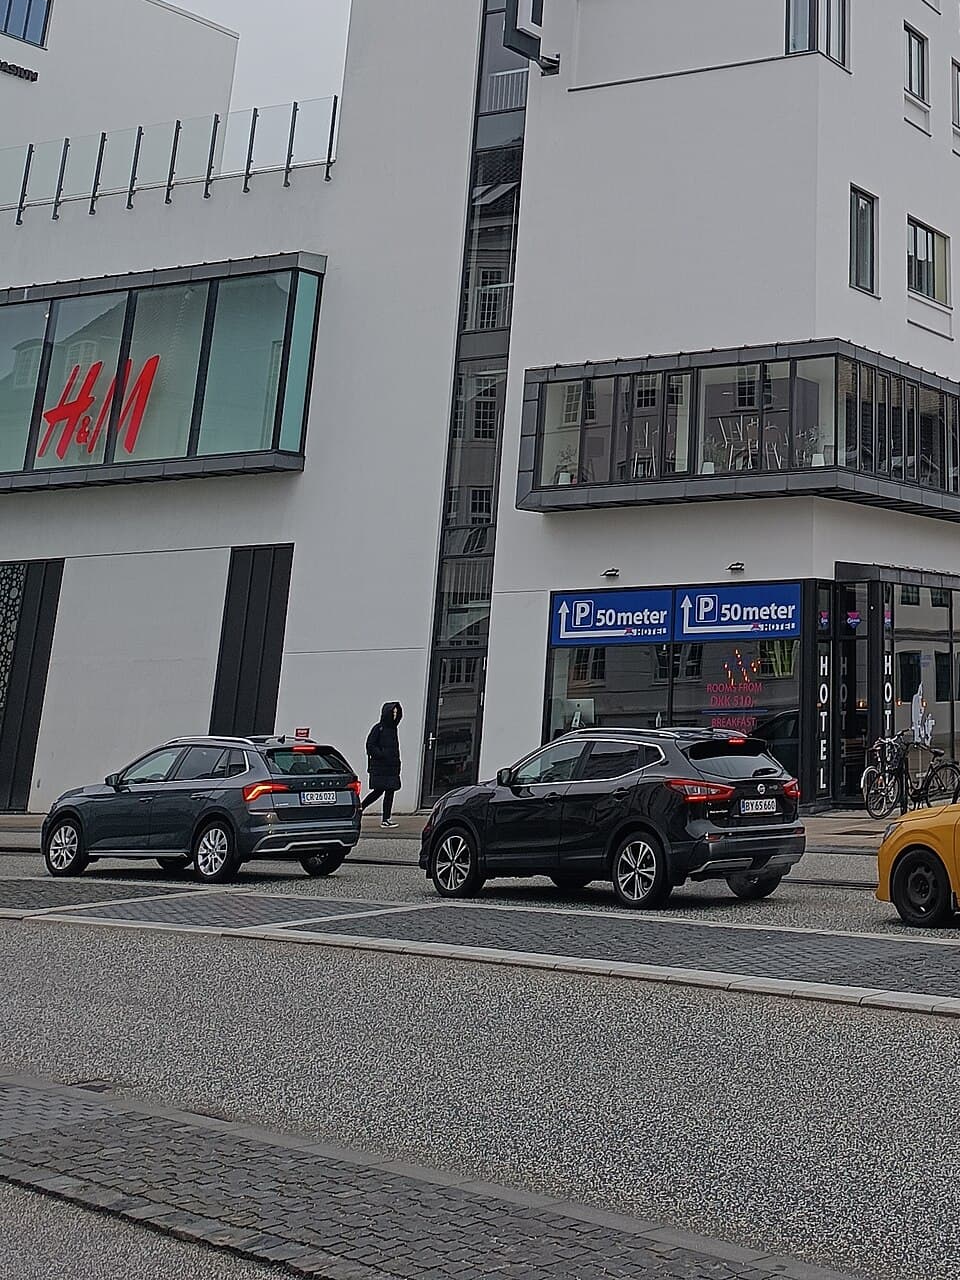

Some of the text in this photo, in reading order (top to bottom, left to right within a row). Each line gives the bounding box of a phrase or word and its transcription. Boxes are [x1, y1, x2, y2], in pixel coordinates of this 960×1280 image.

[38, 355, 160, 460] H&M
[738, 682, 762, 692] FROM
[711, 695, 731, 706] DKK
[711, 716, 757, 728] BREAKFAST
[820, 655, 828, 789] HOTEL
